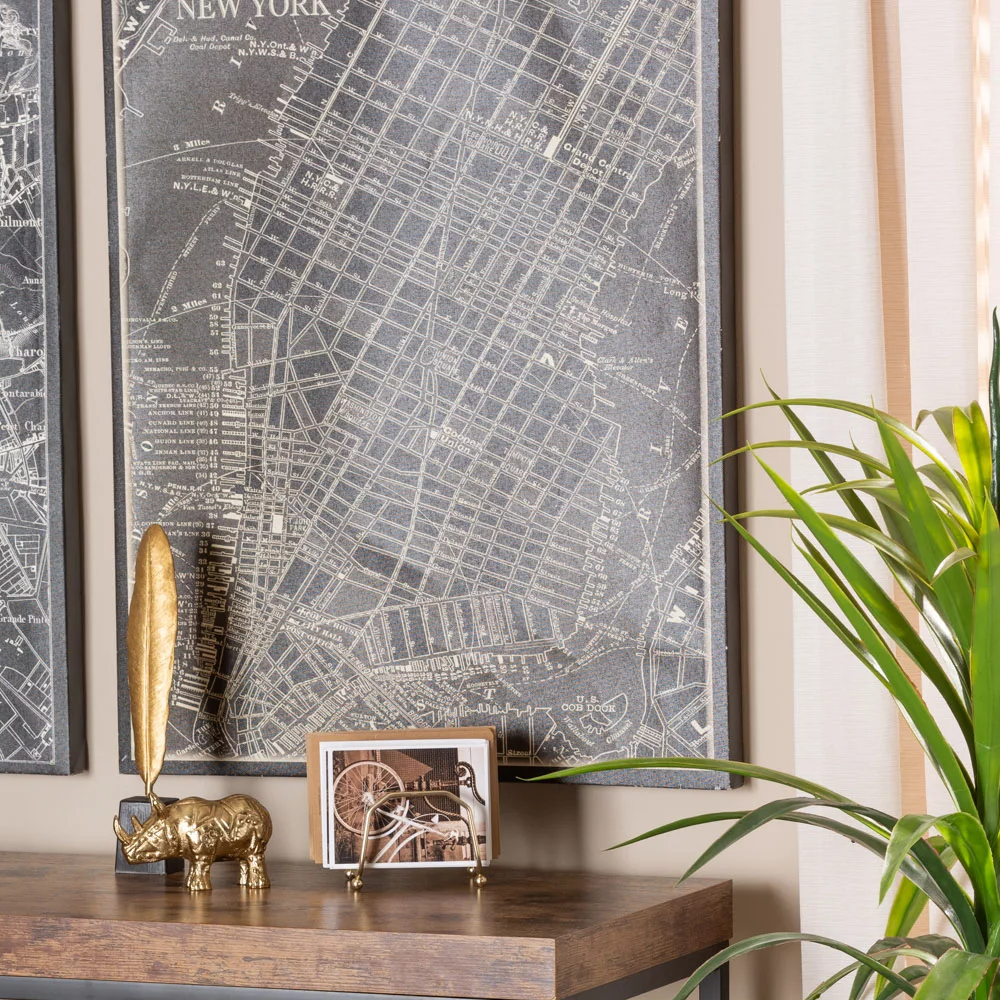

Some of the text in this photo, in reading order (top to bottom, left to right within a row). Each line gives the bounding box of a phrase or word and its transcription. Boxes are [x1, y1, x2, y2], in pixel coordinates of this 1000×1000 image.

[177, 0, 332, 20] NEW YORK
[221, 35, 241, 43] Canal
[572, 156, 604, 178] Depot
[561, 703, 616, 713] COB DOCK
